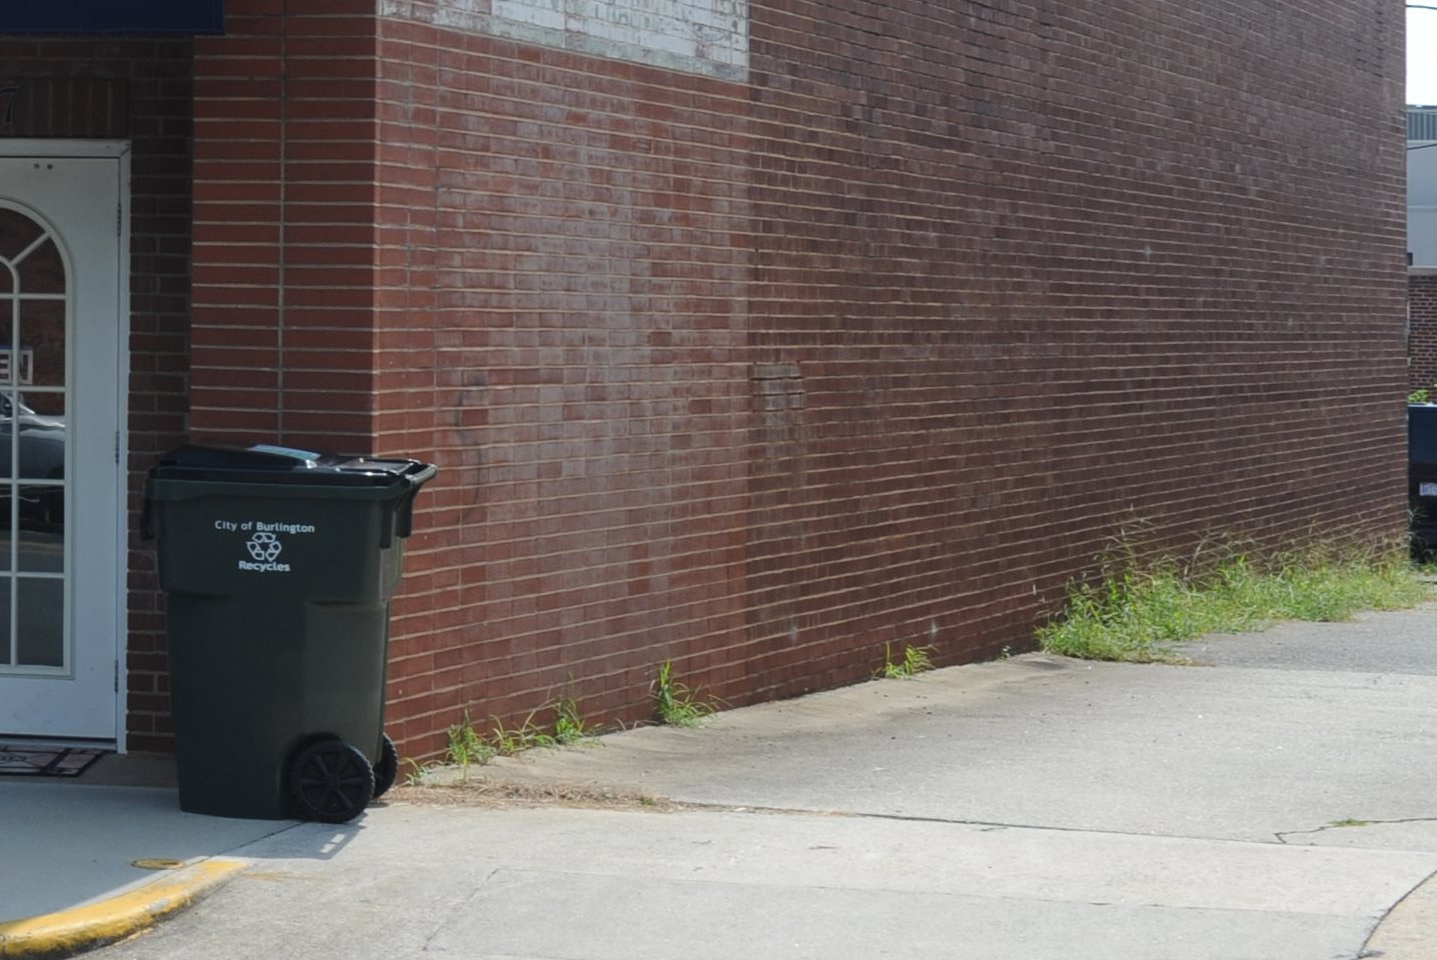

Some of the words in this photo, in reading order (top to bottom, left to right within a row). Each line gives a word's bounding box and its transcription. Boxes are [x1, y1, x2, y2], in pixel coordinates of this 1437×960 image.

[214, 520, 238, 532] City
[241, 521, 253, 530] of
[256, 522, 315, 534] Burlington
[238, 560, 291, 572] Recycles
